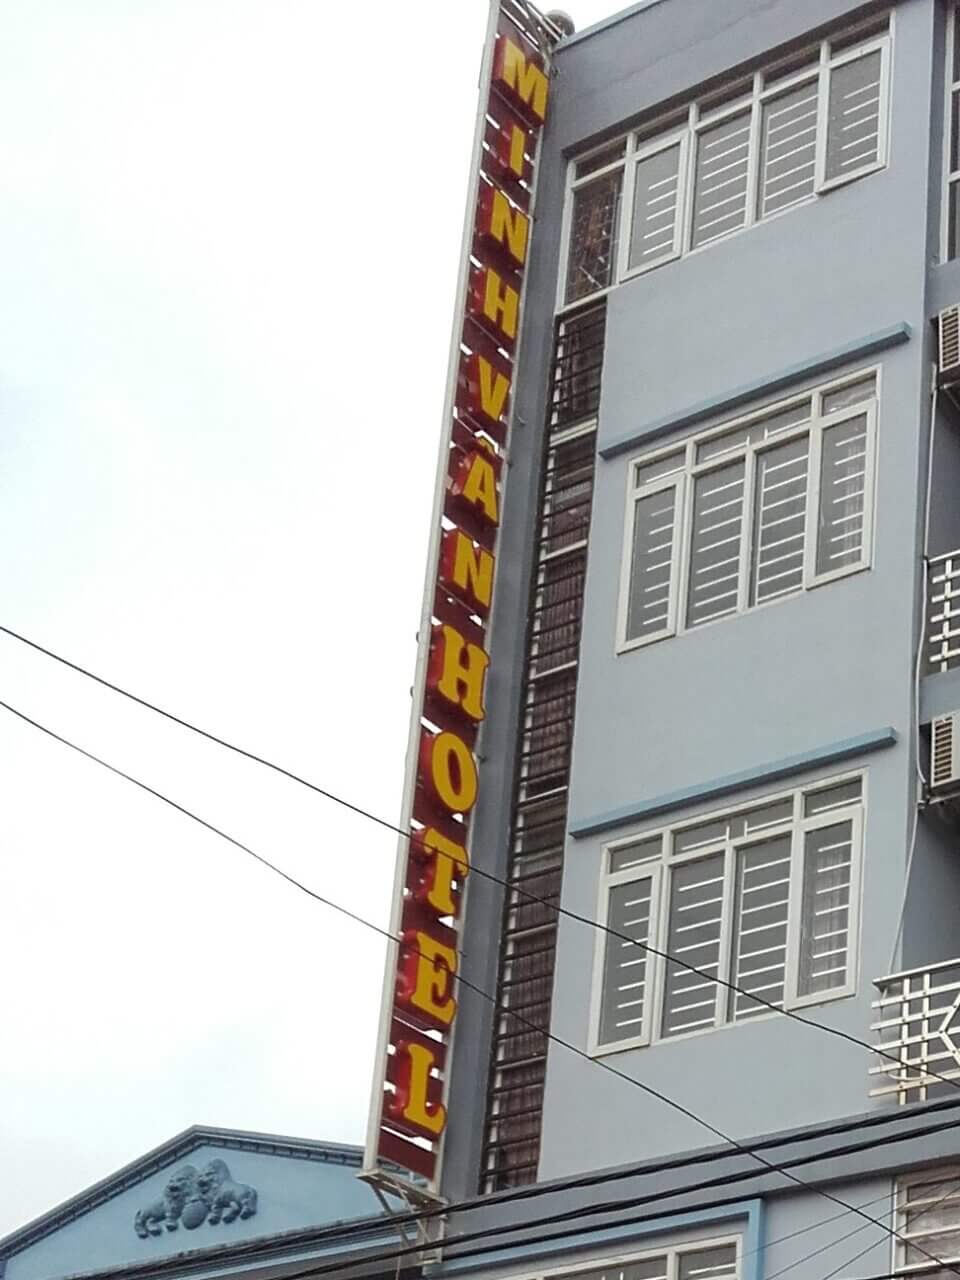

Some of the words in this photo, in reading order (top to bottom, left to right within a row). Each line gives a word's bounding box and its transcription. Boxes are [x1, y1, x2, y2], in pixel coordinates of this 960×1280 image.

[483, 36, 549, 340] MINH
[453, 355, 510, 609] VÂN
[402, 625, 491, 1137] HOTEL
